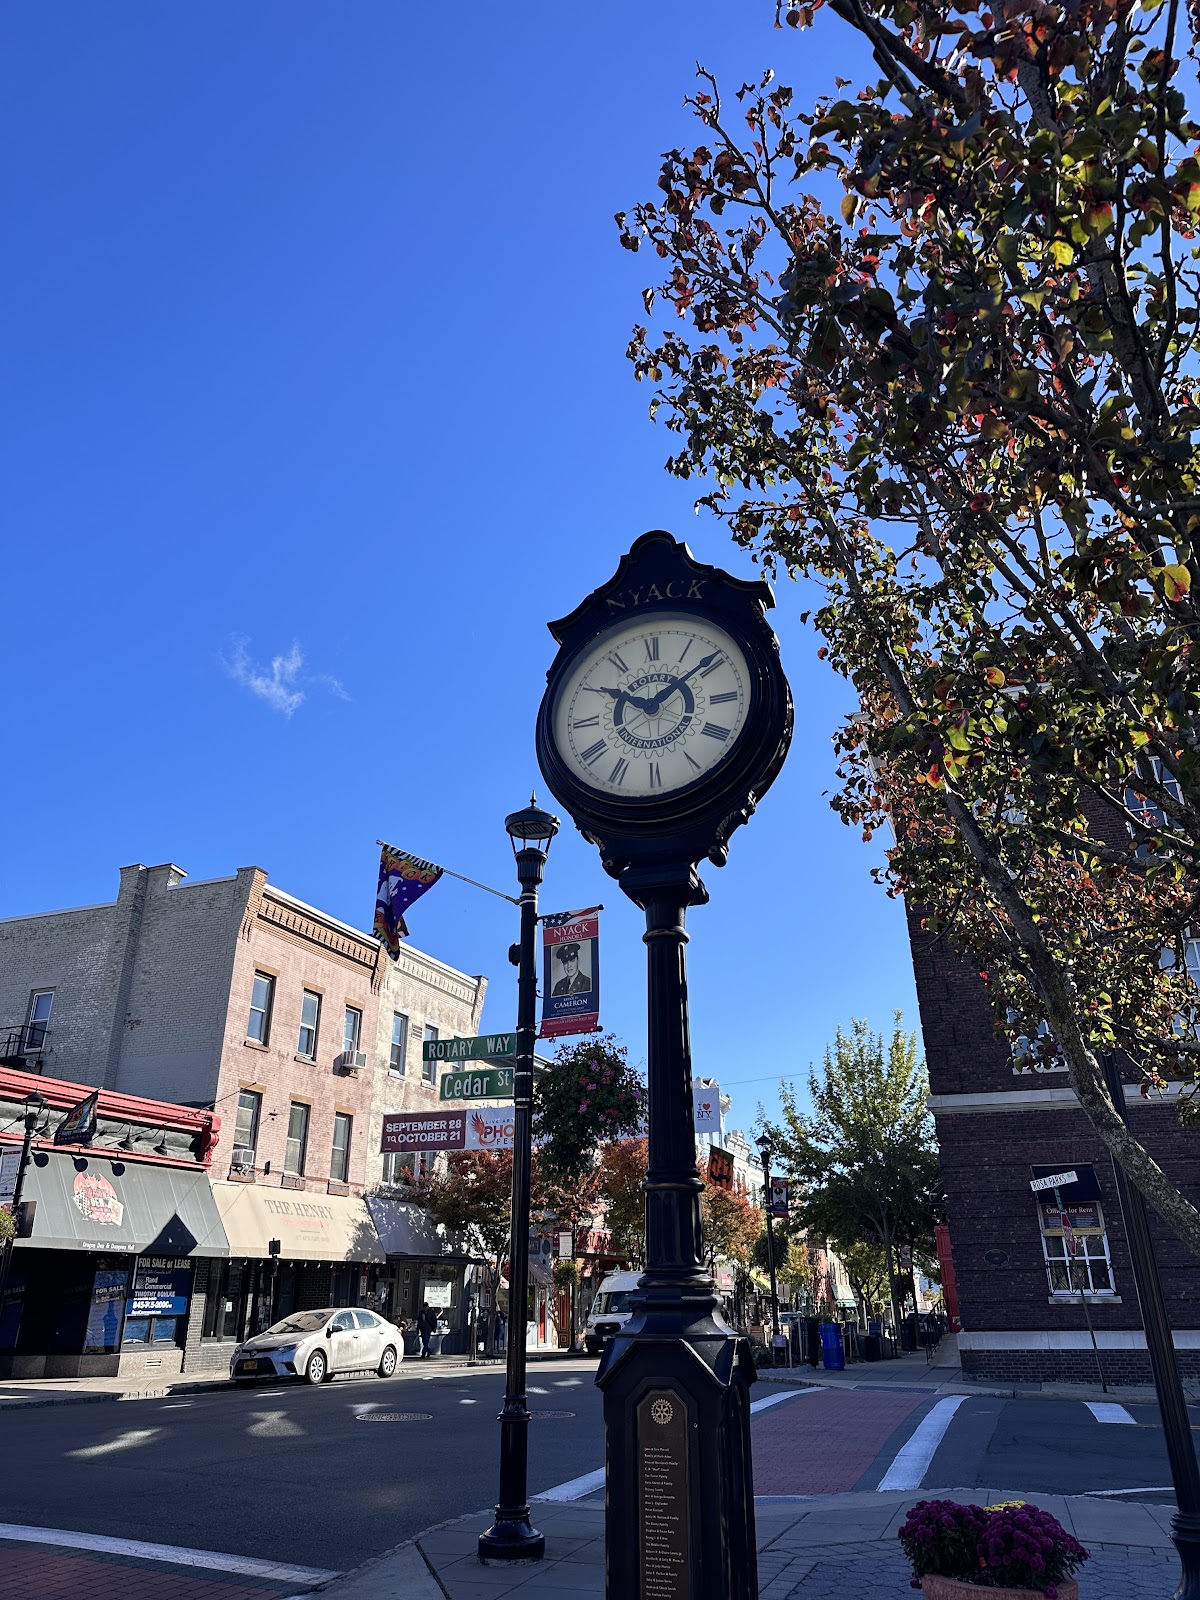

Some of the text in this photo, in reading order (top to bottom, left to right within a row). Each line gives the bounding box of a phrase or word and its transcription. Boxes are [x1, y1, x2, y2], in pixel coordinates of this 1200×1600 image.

[606, 579, 707, 616] NYACK
[644, 637, 660, 663] XII
[608, 652, 630, 674] XI
[632, 674, 673, 690] ROTARY
[710, 691, 738, 705] III
[573, 714, 600, 730] IX
[619, 719, 691, 749] INTERNATIONAL
[649, 761, 662, 788] VI
[553, 922, 590, 938] NYACK
[560, 934, 583, 942] HONORS
[554, 998, 588, 1010] CAMERON
[428, 1036, 510, 1058] ROTARY WAY
[444, 1070, 510, 1098] Cedar St
[386, 1120, 462, 1132] SEPTEMBER 28
[398, 1132, 449, 1143] OCTOBER
[450, 1131, 461, 1140] 21
[1032, 1179, 1048, 1190] ROSA
[1049, 1174, 1067, 1186] PARKS
[264, 1200, 333, 1219] THE HENRY
[138, 1258, 151, 1268] FOR
[152, 1259, 166, 1268] SALE
[174, 1260, 191, 1269] LEASE
